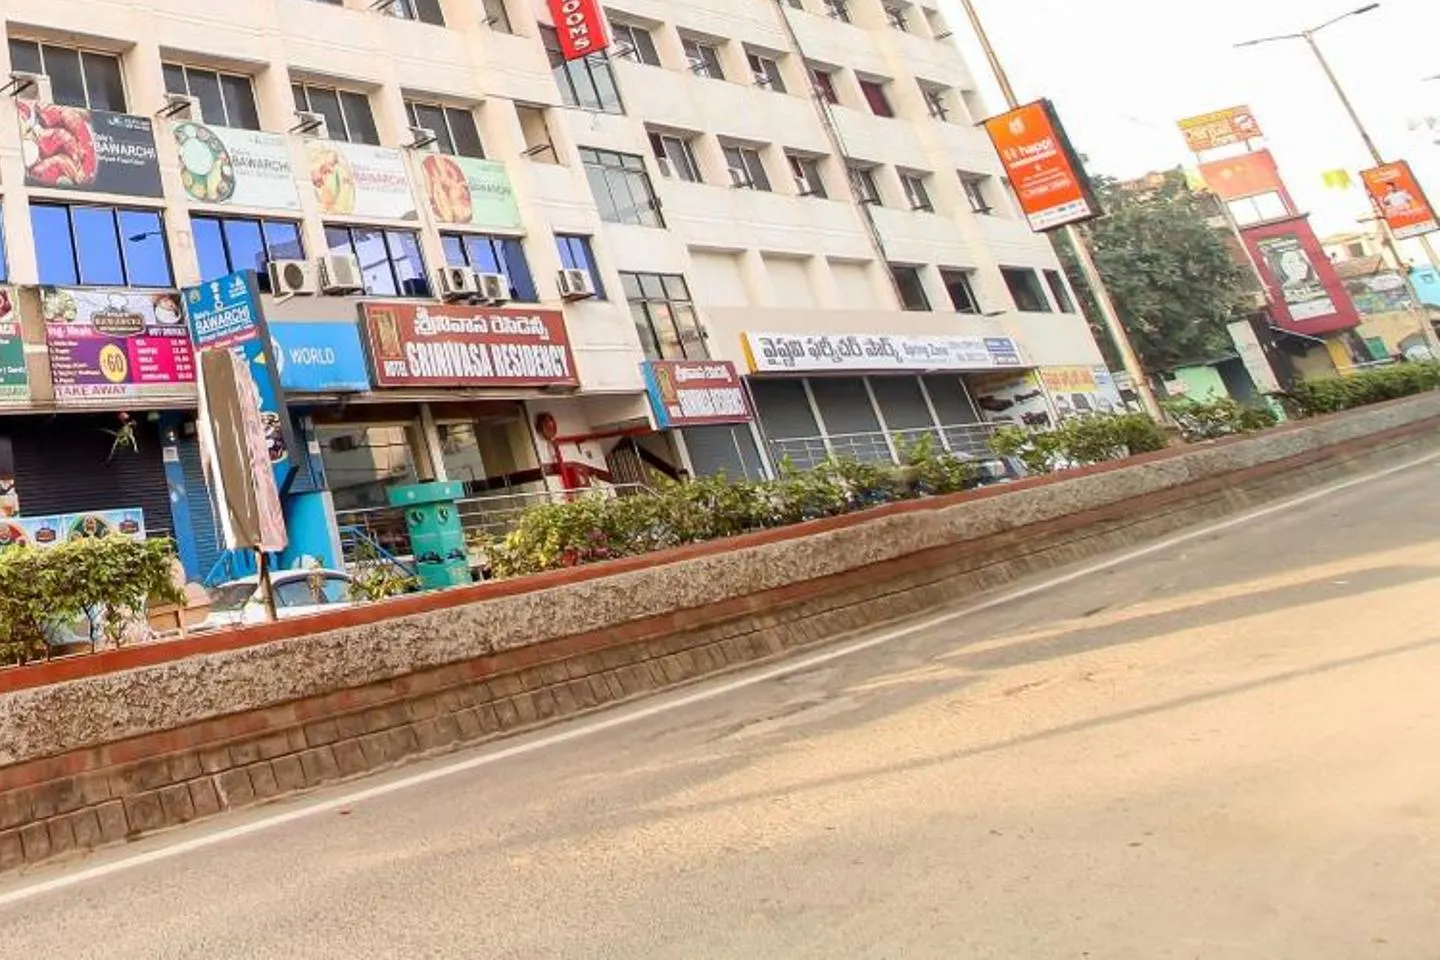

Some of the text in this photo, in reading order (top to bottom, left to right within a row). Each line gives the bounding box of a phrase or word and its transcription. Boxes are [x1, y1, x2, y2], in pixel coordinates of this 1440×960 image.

[93, 142, 157, 159] BAWARCHI
[195, 304, 252, 332] BAWARCHI
[290, 347, 336, 365] WORLD
[406, 340, 570, 377] SRINIVASA RESIDENCY
[56, 384, 128, 397] TAKE AWAY
